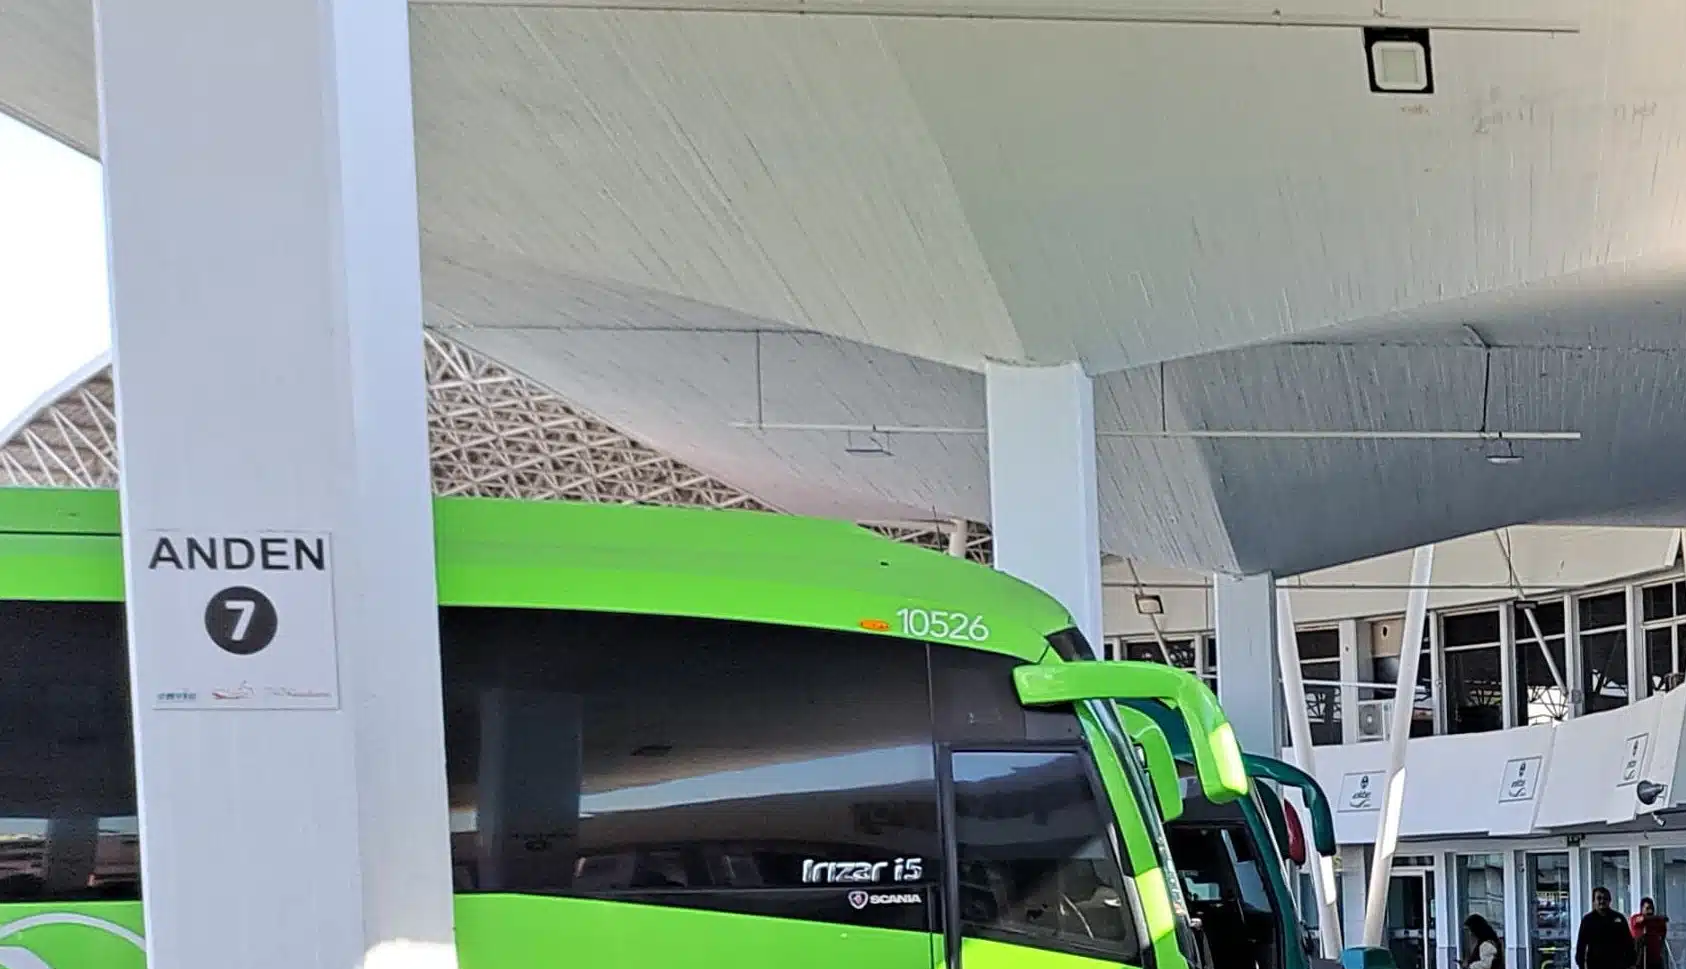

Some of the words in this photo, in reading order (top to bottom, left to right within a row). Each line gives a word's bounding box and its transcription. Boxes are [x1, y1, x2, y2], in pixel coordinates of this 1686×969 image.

[148, 536, 326, 571] ANDEN
[225, 600, 256, 641] 7
[896, 608, 990, 642] 10526
[894, 858, 922, 881] i5
[870, 894, 922, 904] SCANIA
